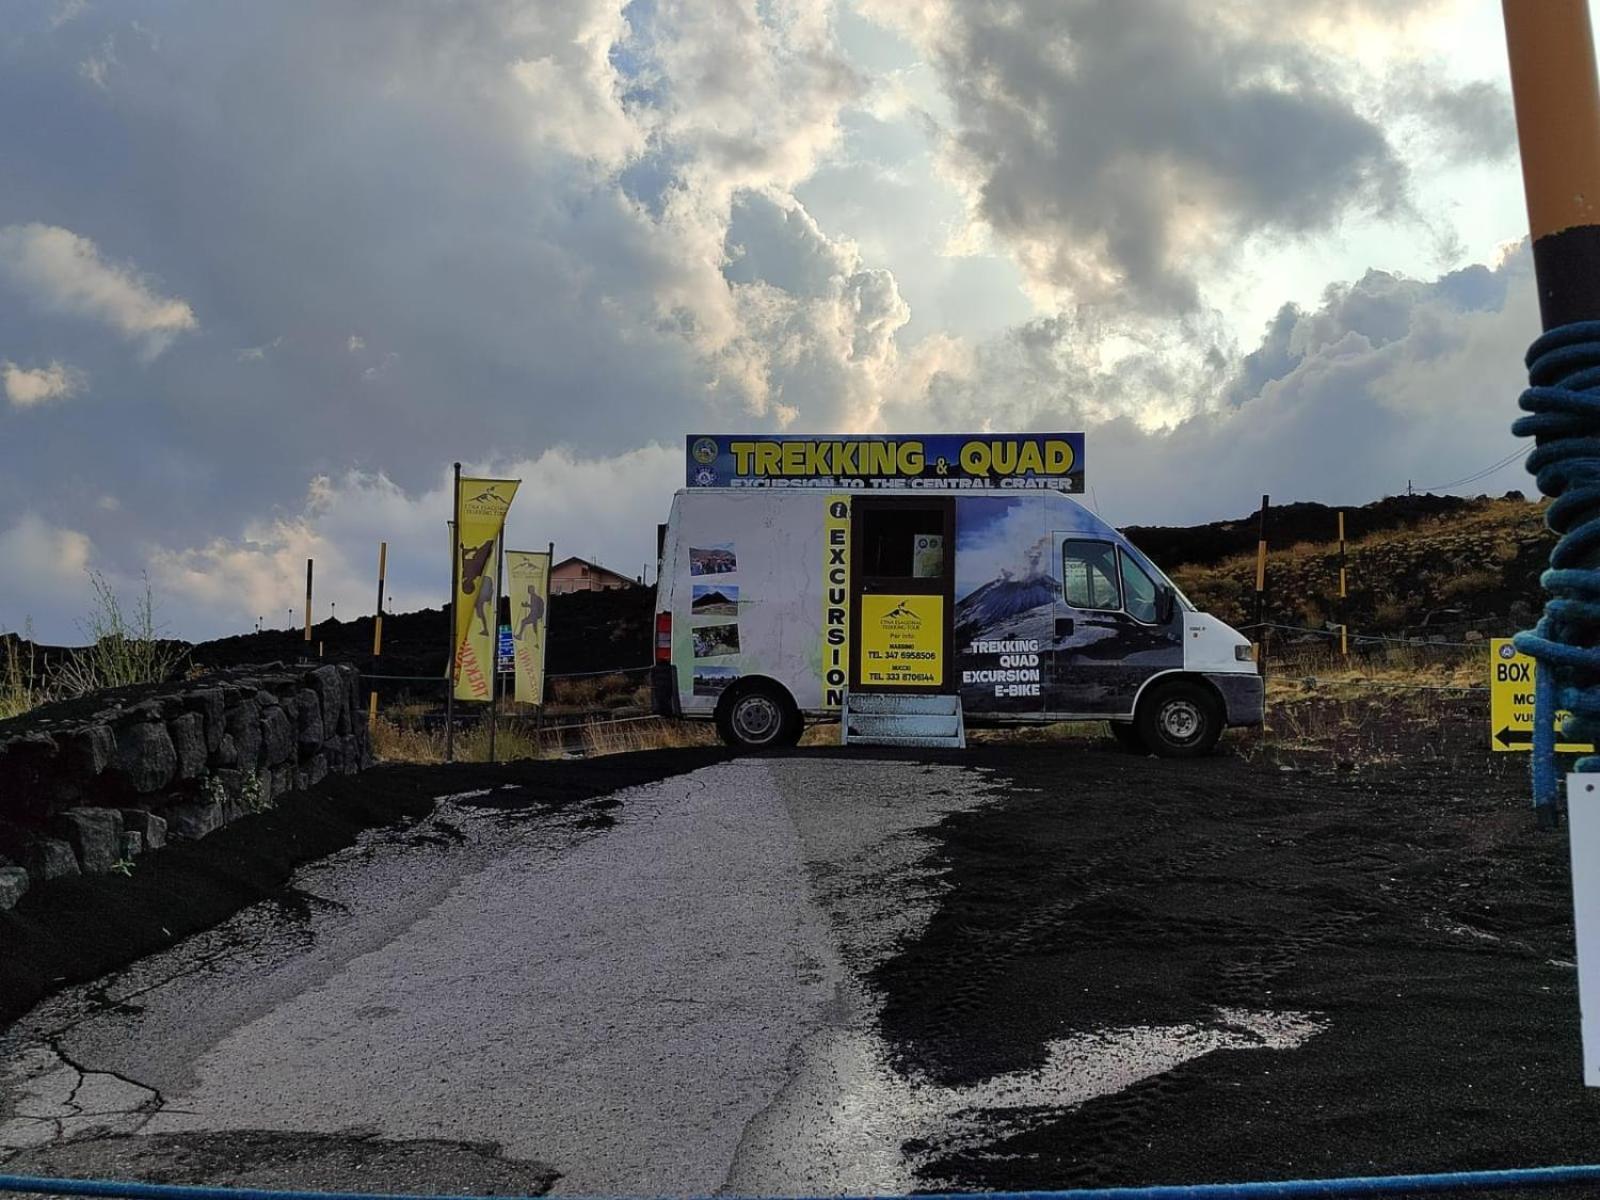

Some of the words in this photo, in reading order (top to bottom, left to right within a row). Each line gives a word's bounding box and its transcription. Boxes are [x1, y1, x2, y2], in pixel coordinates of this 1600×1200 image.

[730, 441, 925, 476] TREKKING
[936, 457, 948, 475] &
[960, 440, 1074, 476] QUAD
[870, 478, 905, 488] THE
[911, 477, 995, 489] CENTRAL
[1000, 477, 1073, 490] CRATER
[826, 528, 846, 706] EXCURSION
[970, 640, 1039, 653] TREKKING
[1000, 654, 1040, 668] QUAD
[962, 669, 1040, 683] EXCURSION
[1497, 663, 1531, 682] BOX
[994, 684, 1041, 697] E-BIKE
